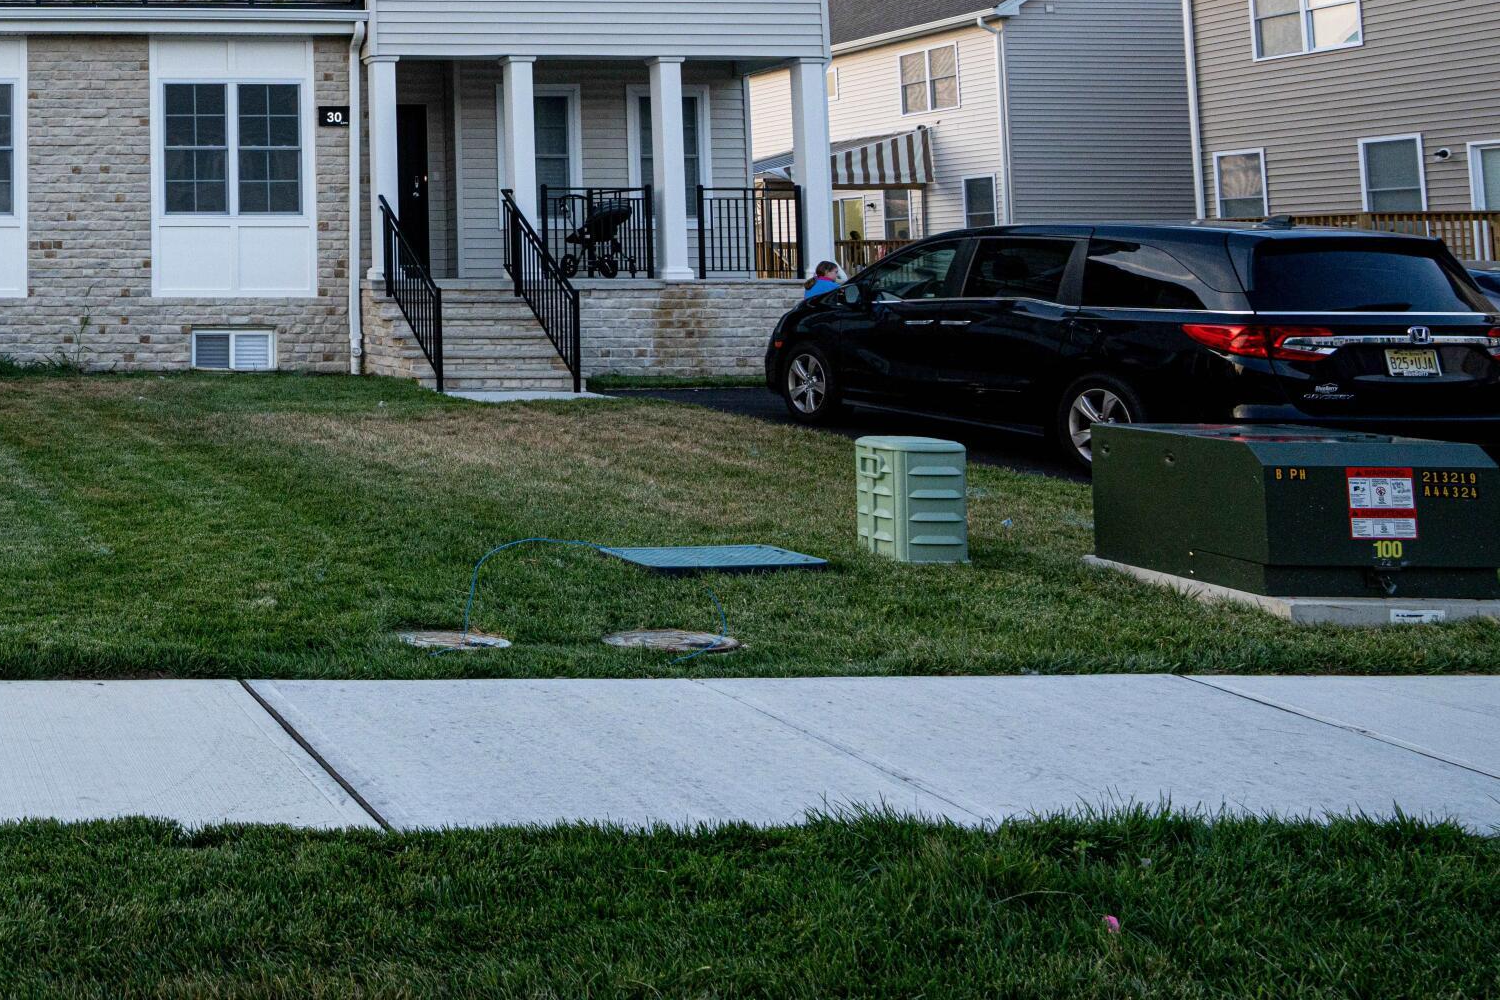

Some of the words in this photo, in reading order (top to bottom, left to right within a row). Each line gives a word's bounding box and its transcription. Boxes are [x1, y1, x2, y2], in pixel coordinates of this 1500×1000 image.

[326, 111, 342, 123] 30
[1422, 471, 1476, 484] 213219
[1424, 485, 1477, 499] A44324
[1373, 540, 1403, 558] 100
